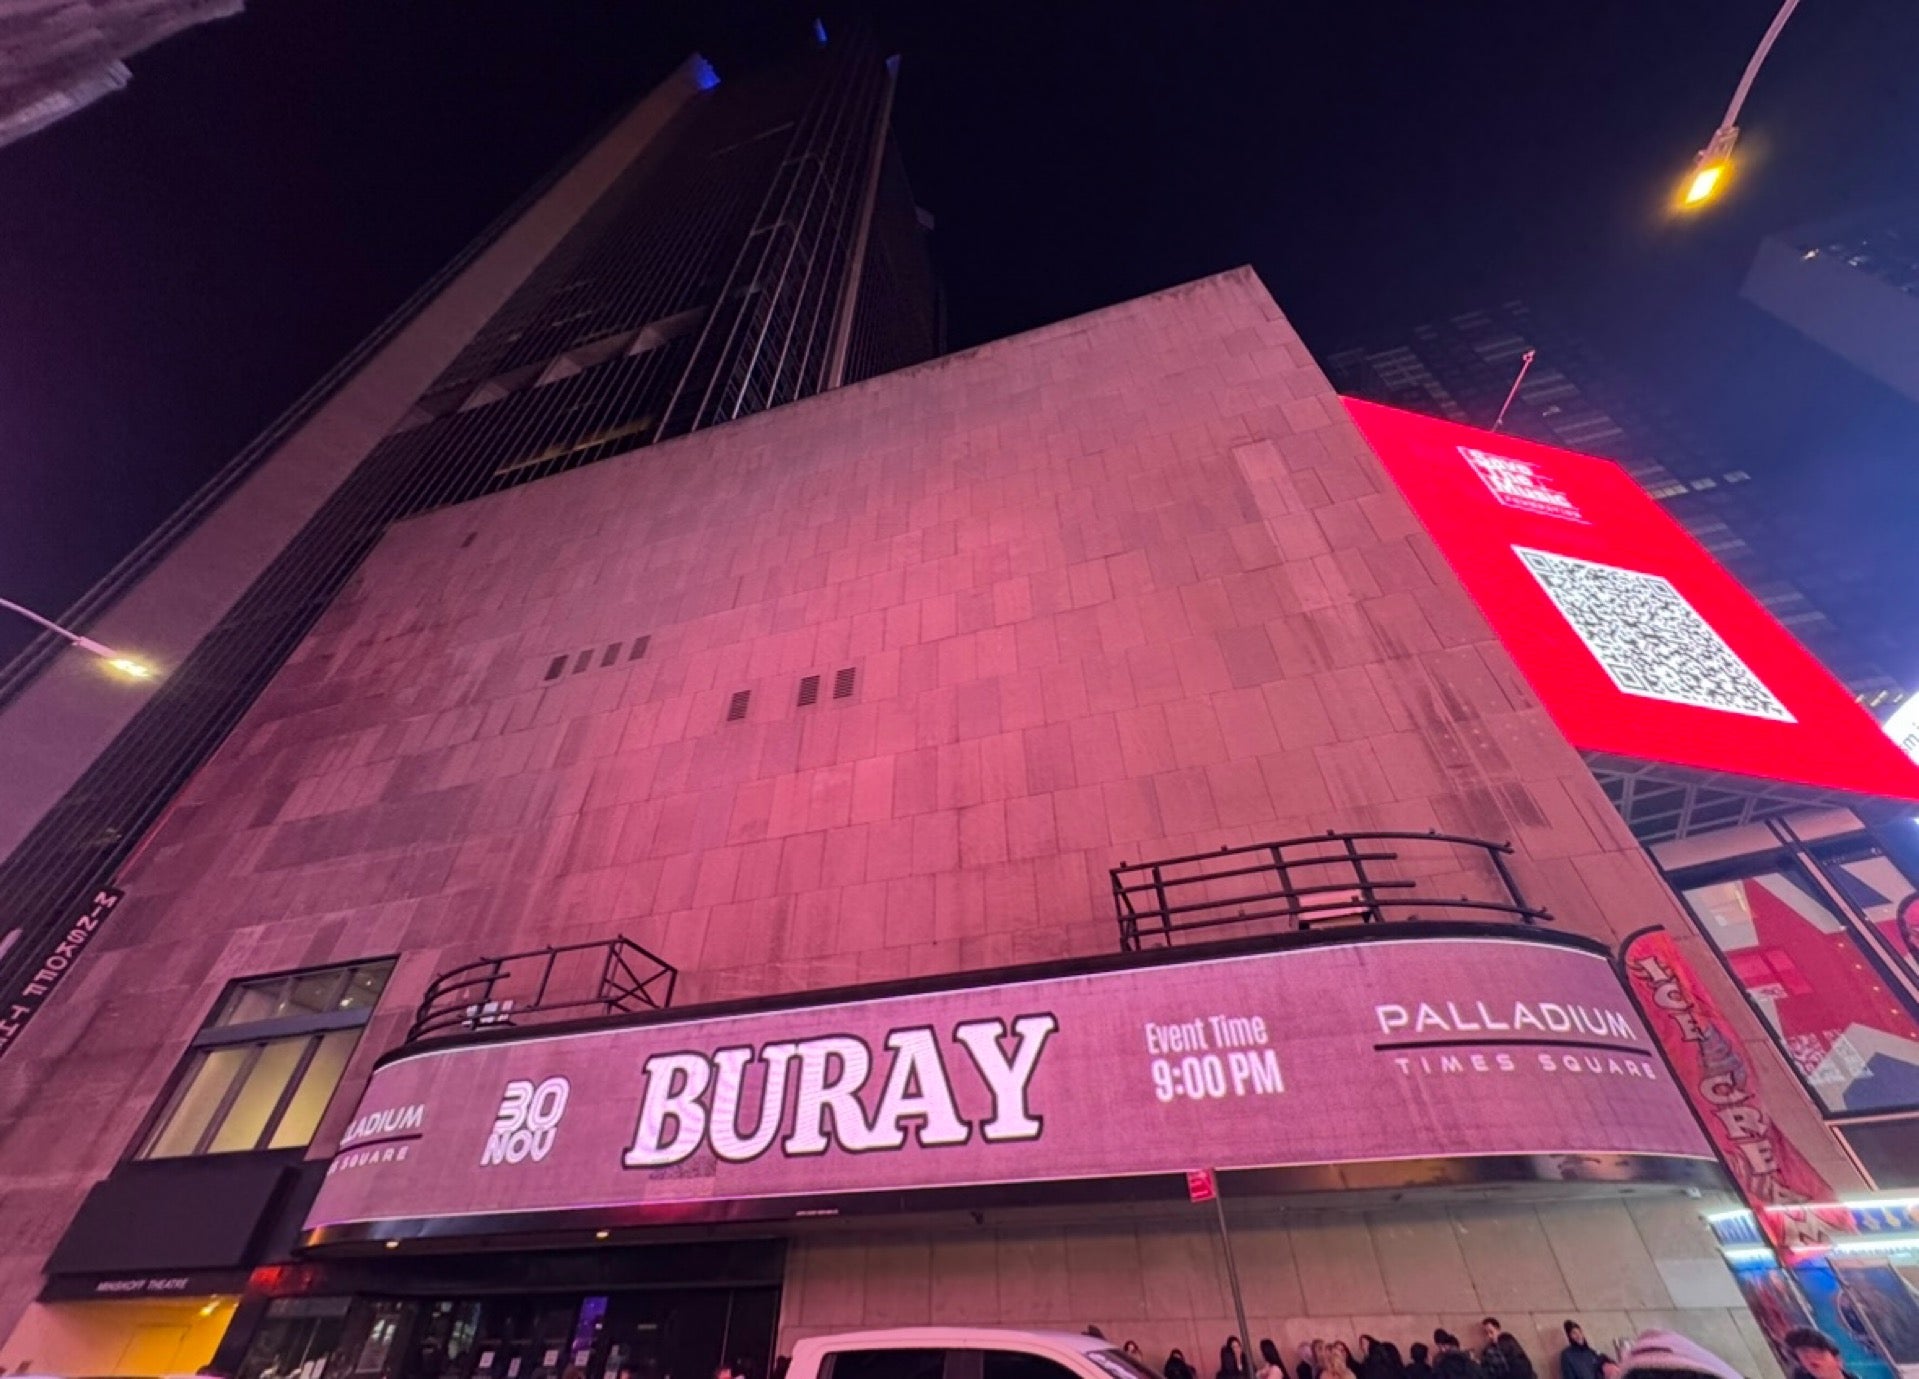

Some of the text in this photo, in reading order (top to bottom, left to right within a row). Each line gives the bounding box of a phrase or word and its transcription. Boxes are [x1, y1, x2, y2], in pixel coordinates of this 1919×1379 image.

[22, 891, 118, 997] MINSKOFF
[1143, 1013, 1270, 1055] Event Time
[1373, 1000, 1638, 1041] PALLADIUM
[621, 1012, 1059, 1170] BURAY
[1151, 1048, 1286, 1103] 9:00 PM
[1395, 1053, 1658, 1080] TIMES SQUARE
[494, 1076, 571, 1134] 30
[1628, 956, 1836, 1249] ICE CREAM
